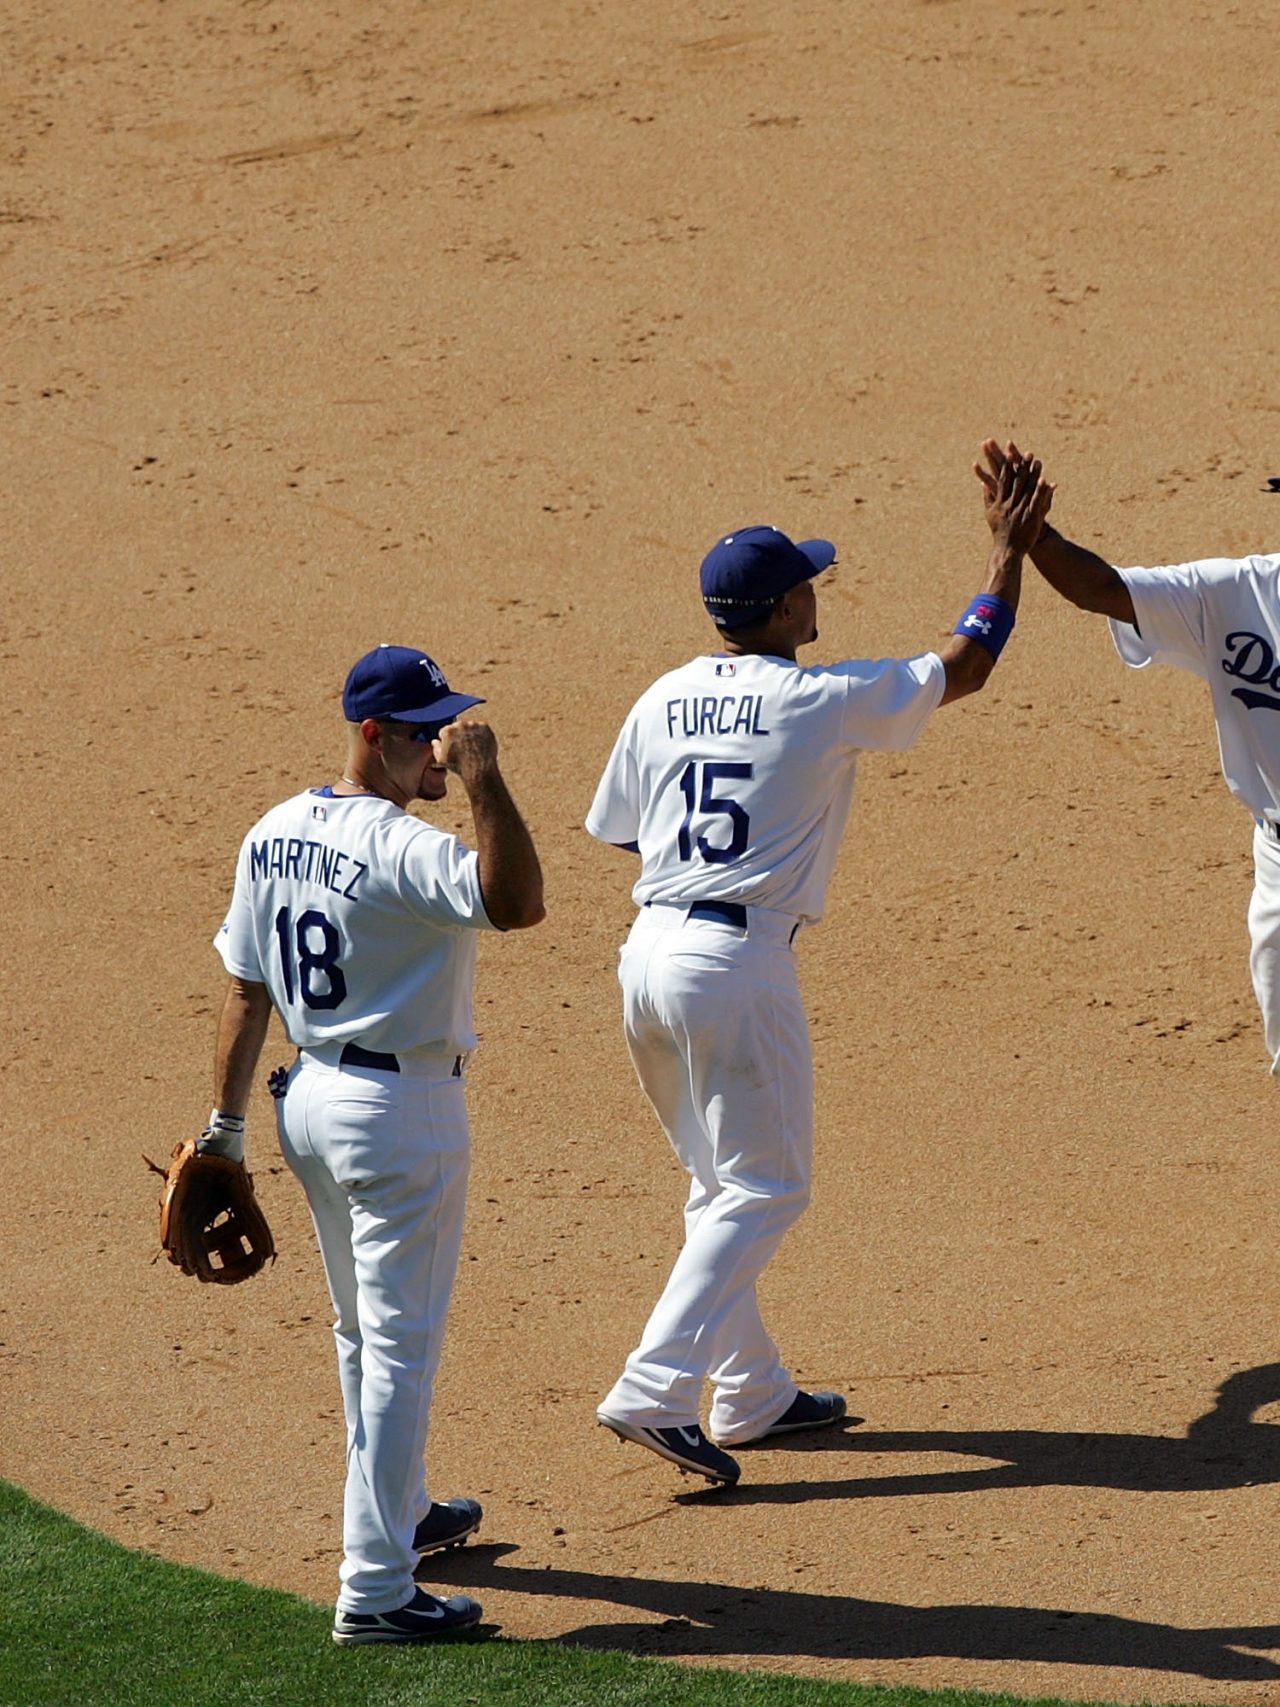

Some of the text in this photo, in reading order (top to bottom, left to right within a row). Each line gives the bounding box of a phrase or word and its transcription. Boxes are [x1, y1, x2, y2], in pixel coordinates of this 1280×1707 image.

[667, 695, 770, 738] FURCAL
[678, 762, 753, 865] 15
[251, 838, 368, 902] MARTINEZ
[276, 906, 347, 1010] 18
